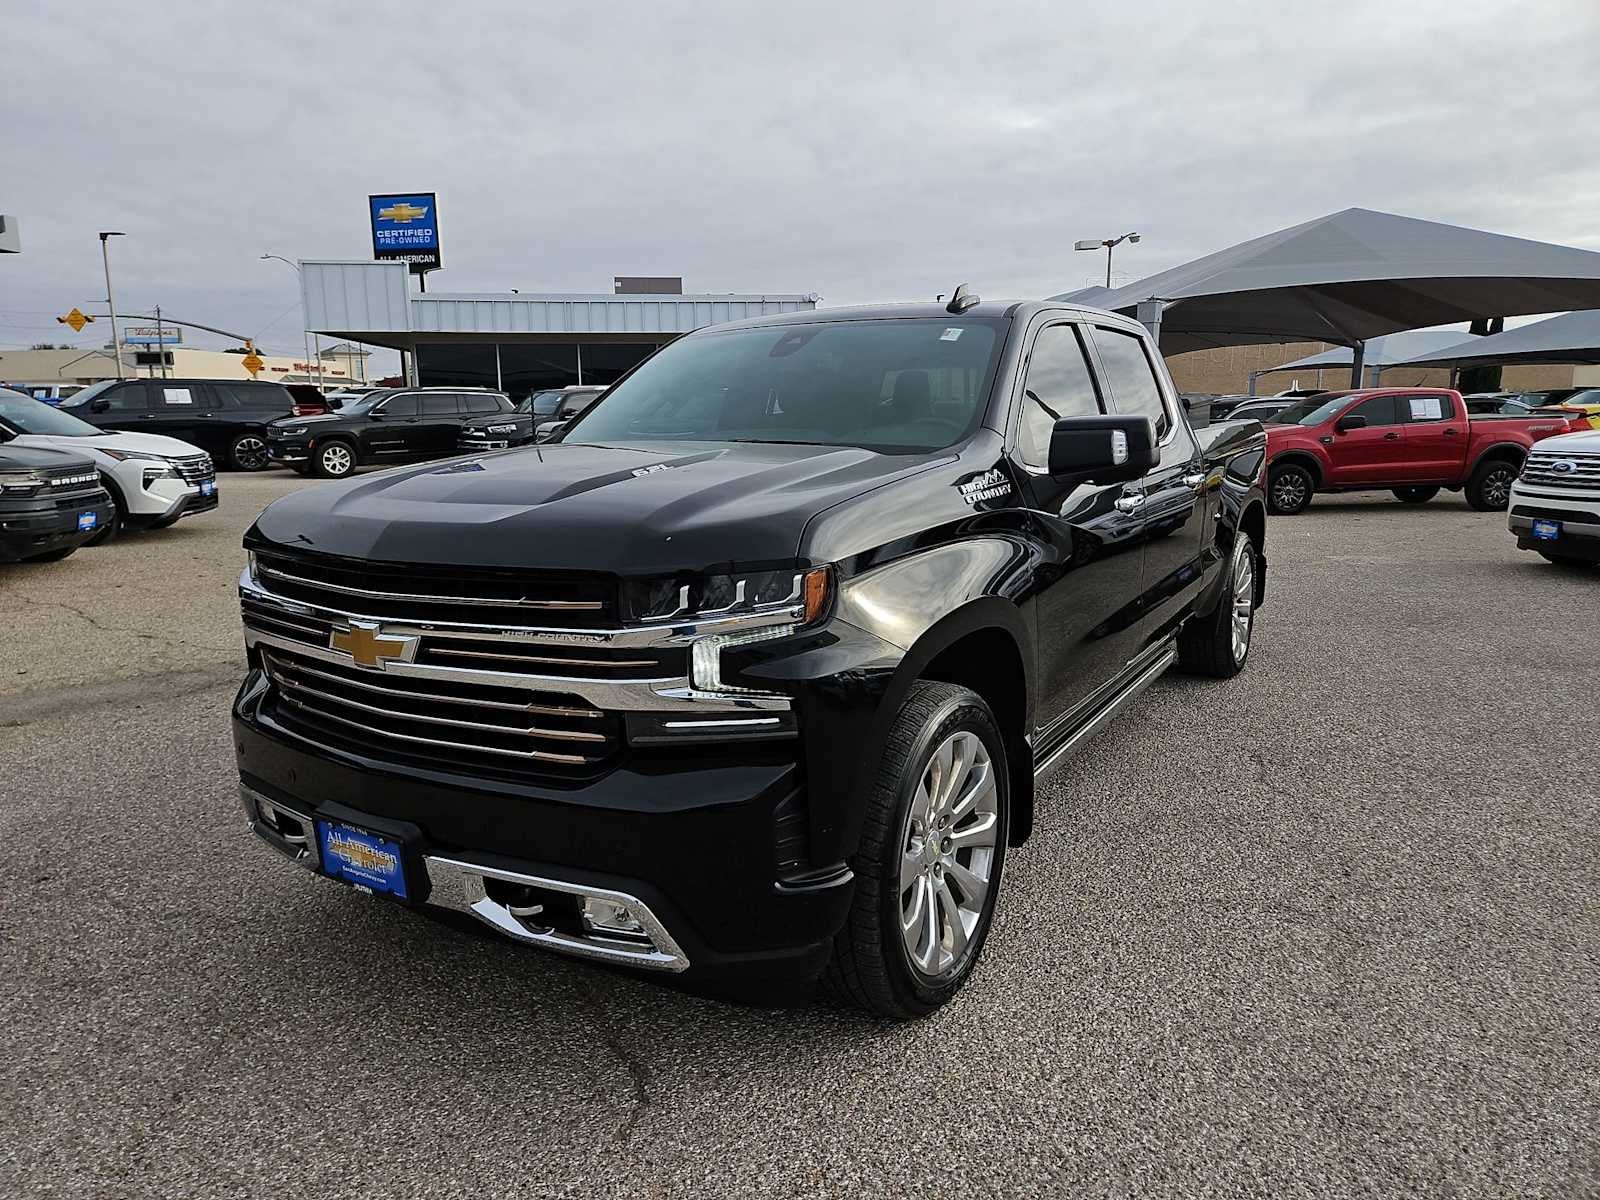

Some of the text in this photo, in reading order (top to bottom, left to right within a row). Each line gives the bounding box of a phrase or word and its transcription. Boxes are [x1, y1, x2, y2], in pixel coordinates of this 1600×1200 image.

[376, 229, 432, 238] CERTIFIED
[380, 236, 430, 244] PRE-OWNED
[960, 480, 988, 495] HIGH
[965, 483, 1011, 503] COUNTRY
[327, 831, 398, 864] All American
